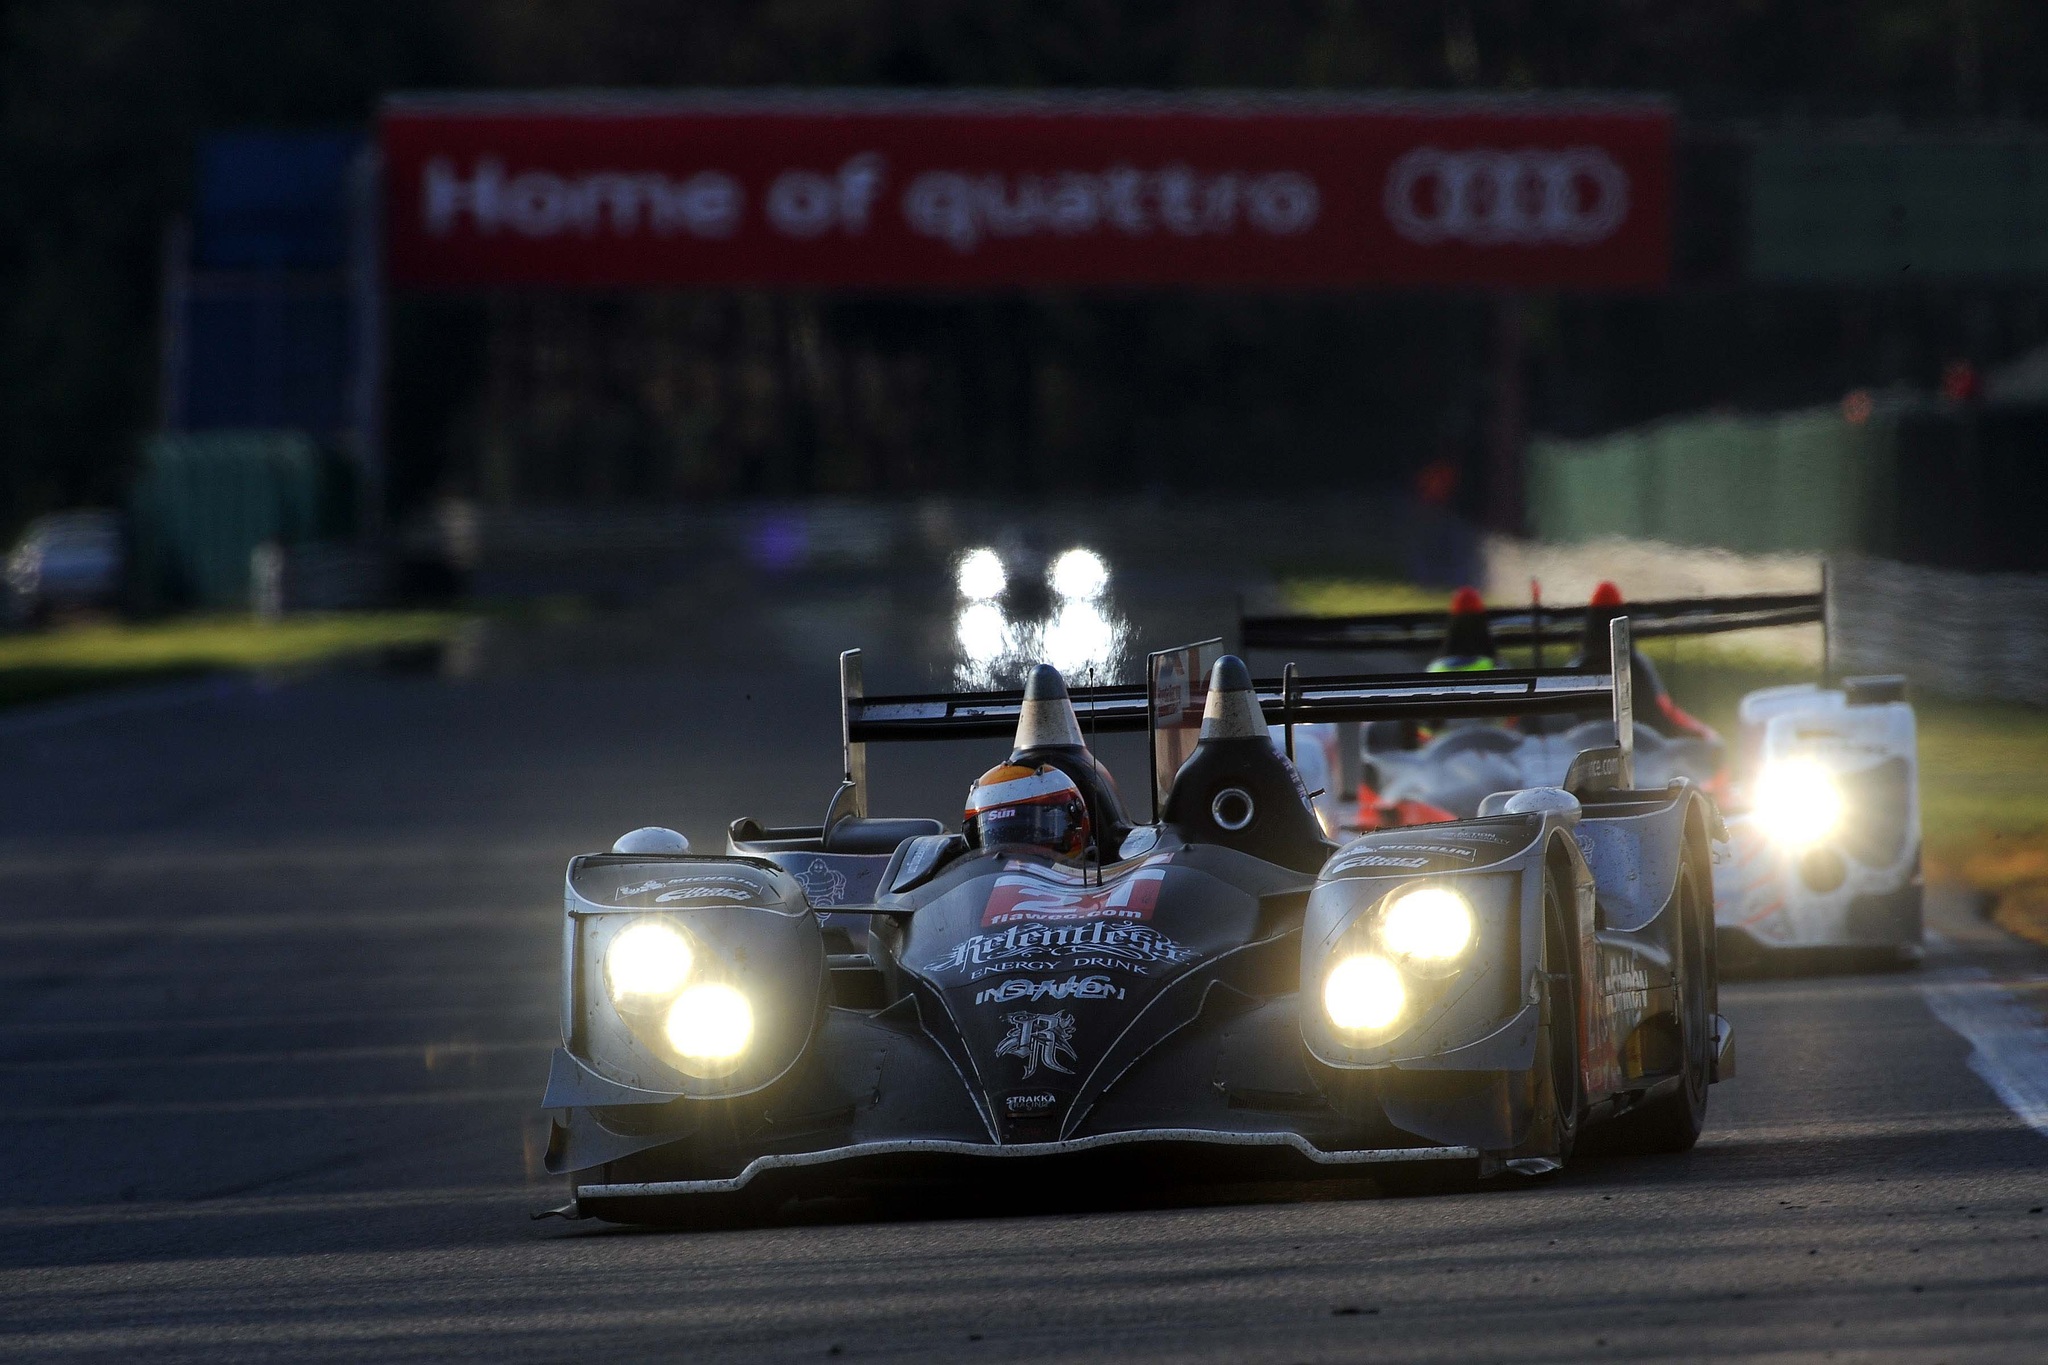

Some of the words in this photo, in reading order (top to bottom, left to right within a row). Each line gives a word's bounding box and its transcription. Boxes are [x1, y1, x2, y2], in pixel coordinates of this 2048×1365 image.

[423, 156, 742, 237] Home
[768, 150, 885, 236] of
[905, 162, 1321, 253] quattro
[1379, 845, 1471, 856] MICHELIN
[993, 869, 1167, 912] 21
[930, 920, 1195, 972] Relentless
[971, 961, 1061, 980] ENERGY
[1074, 957, 1148, 975] DRINK
[1006, 1095, 1056, 1104] STRAKKA
